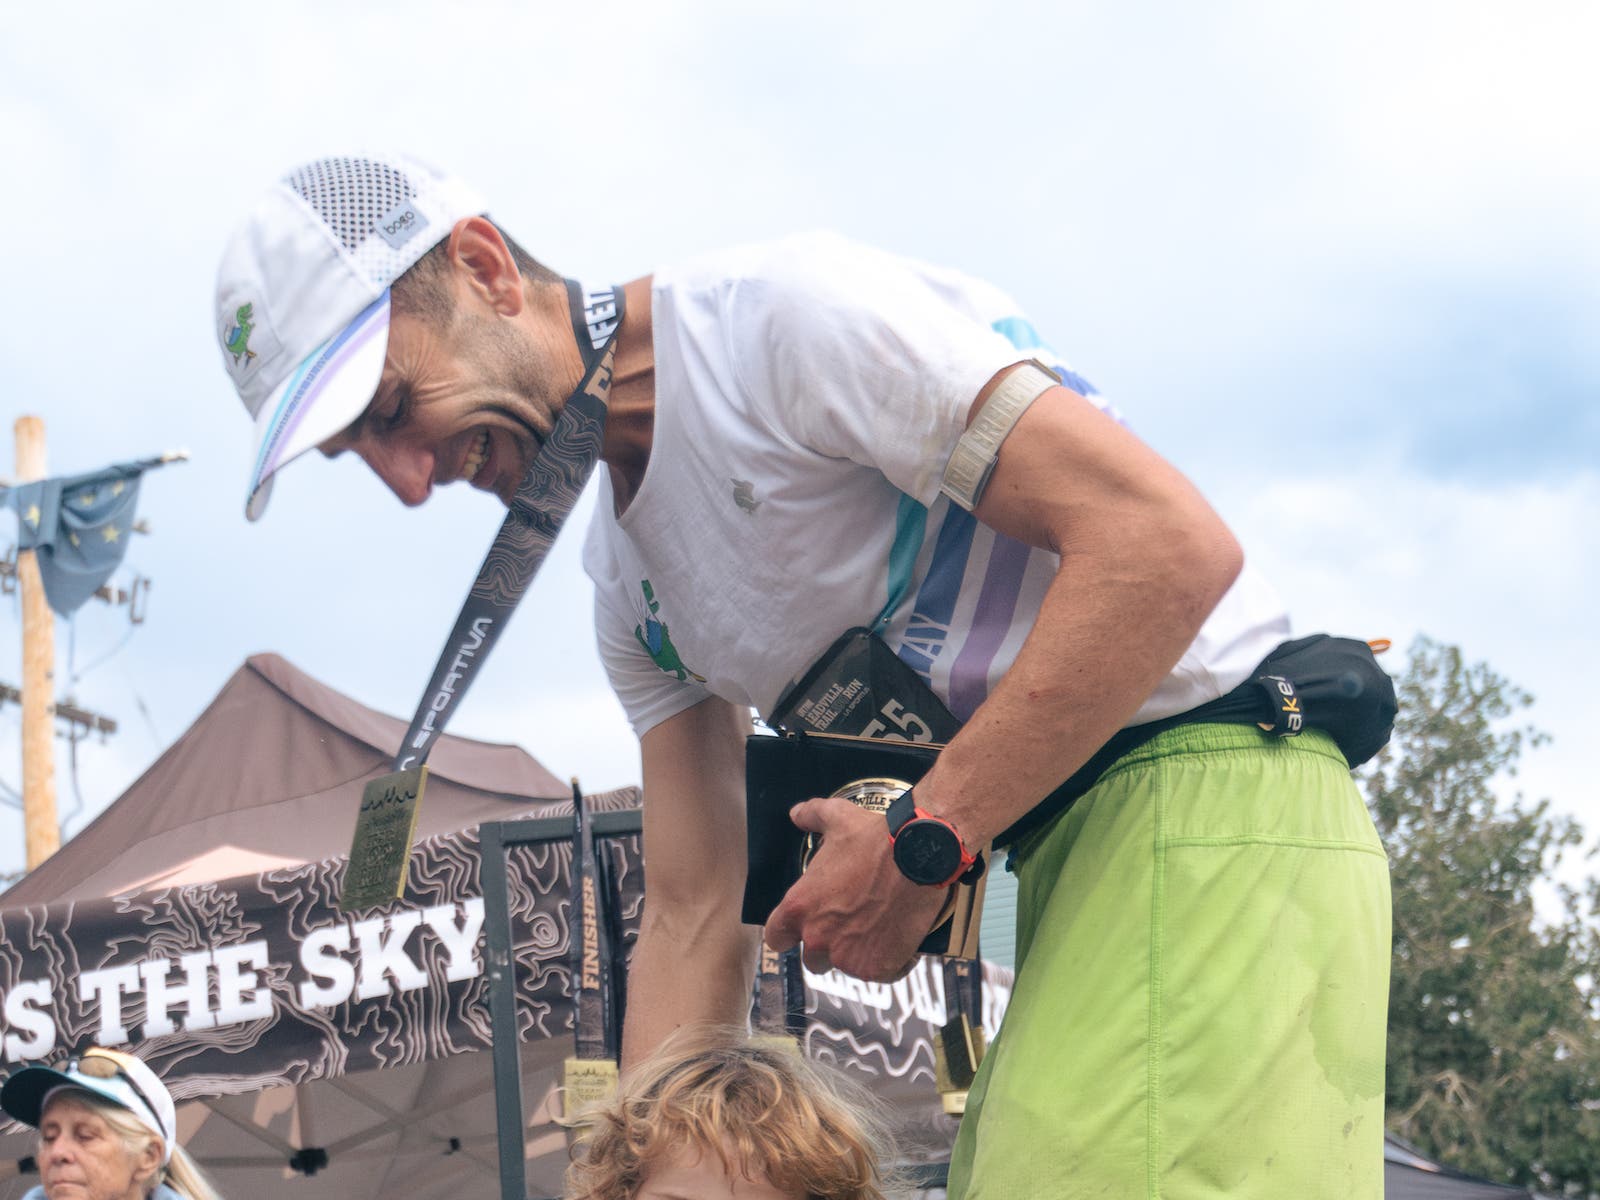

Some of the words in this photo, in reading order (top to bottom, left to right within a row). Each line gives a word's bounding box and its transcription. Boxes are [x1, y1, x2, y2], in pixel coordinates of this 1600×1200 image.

[413, 617, 493, 749] SPORTIVA
[900, 612, 952, 680] AY
[804, 683, 844, 726] LEADVILLE
[815, 709, 839, 732] TRAIL
[842, 679, 864, 700] RUN
[581, 876, 600, 991] FINISHER
[0, 979, 57, 1063] S
[80, 939, 274, 1047] THE
[300, 897, 486, 1011] SKY
